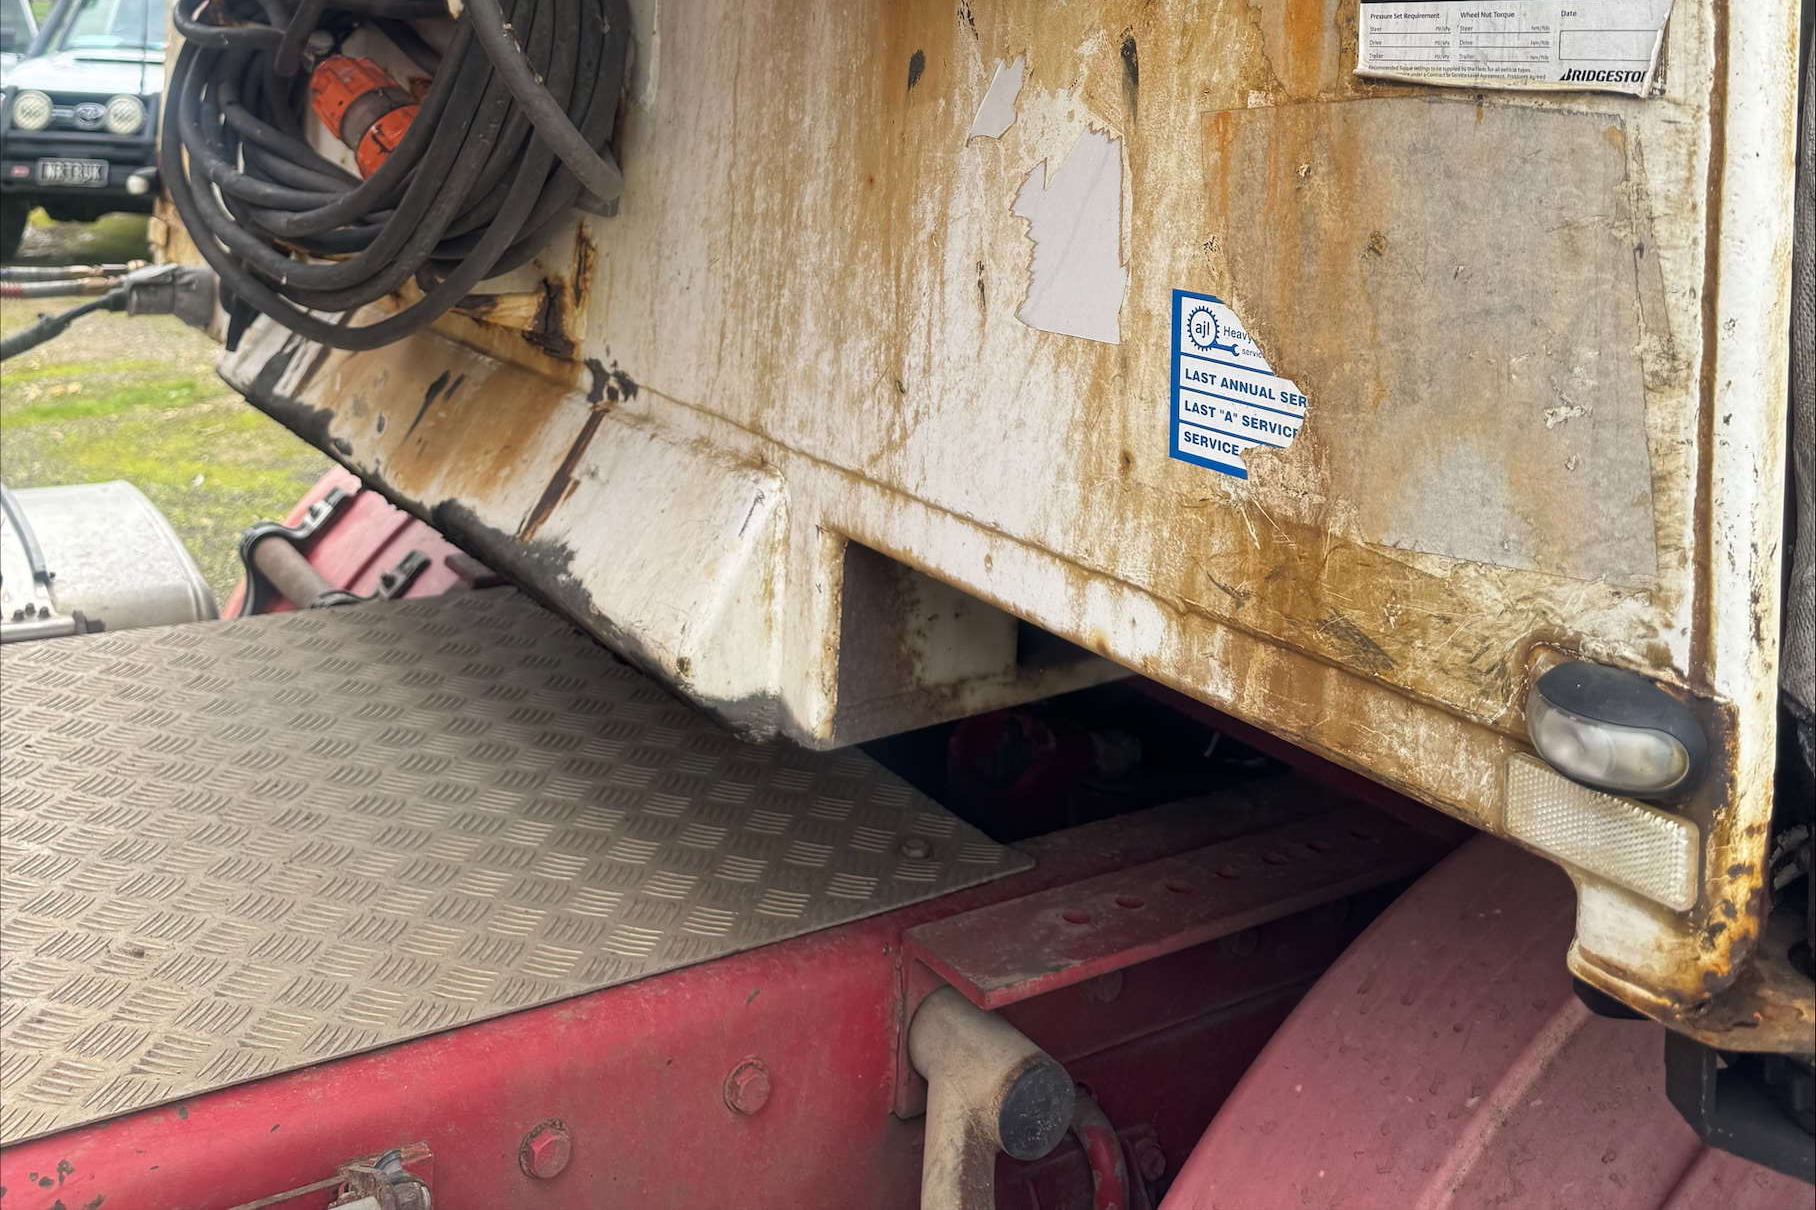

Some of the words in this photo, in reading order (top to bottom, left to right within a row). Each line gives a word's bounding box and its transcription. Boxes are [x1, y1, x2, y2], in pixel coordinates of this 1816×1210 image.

[1404, 12, 1440, 20] Requirement
[1493, 11, 1515, 19] Torque
[1195, 321, 1210, 339] ajl
[1224, 326, 1253, 344] Heavy
[1185, 368, 1217, 386] LAST
[1220, 377, 1276, 401] ANNUAL
[1280, 391, 1308, 408] SER
[1184, 400, 1216, 418] LAST
[1220, 410, 1238, 423] "A"
[1184, 432, 1240, 456] SERVICE
